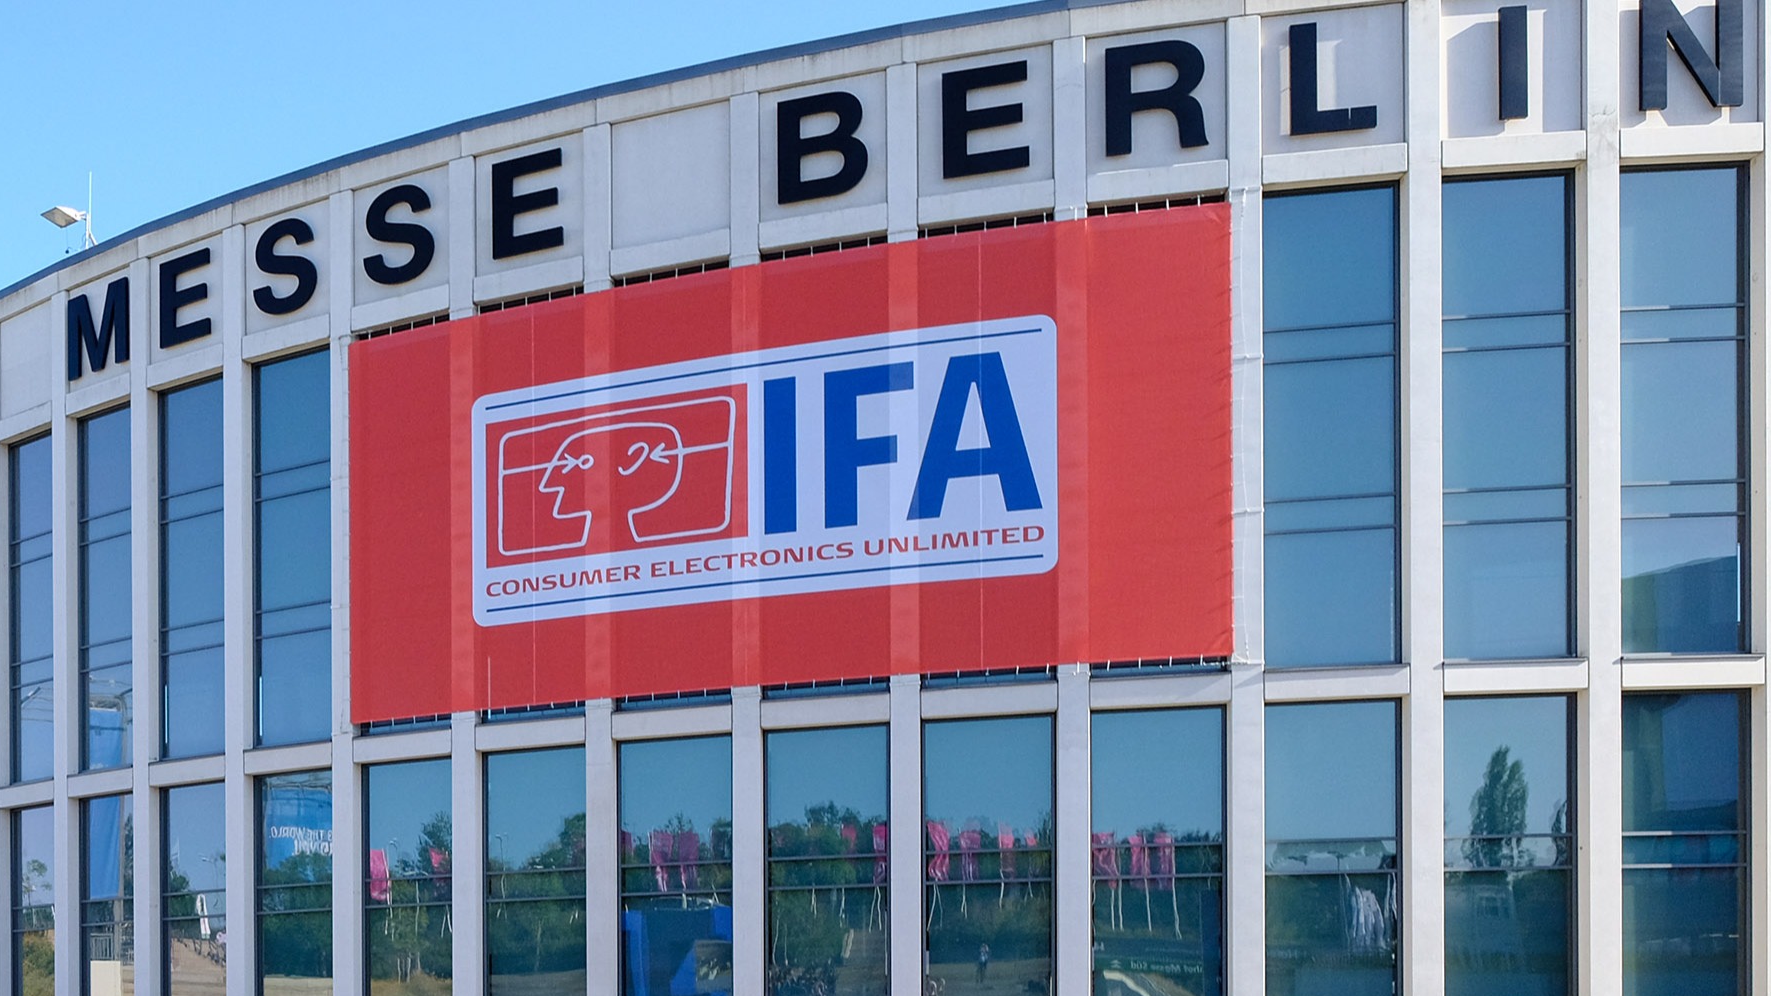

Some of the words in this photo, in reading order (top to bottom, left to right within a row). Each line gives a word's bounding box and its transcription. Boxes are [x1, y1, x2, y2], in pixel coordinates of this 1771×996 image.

[67, 147, 565, 381] MESSE
[777, 0, 1744, 205] BERLIN
[762, 351, 1044, 536] IFA
[485, 563, 641, 598] CONSUMER
[650, 541, 855, 579] ELECTRONICS
[863, 525, 1045, 558] UNLIMITED
